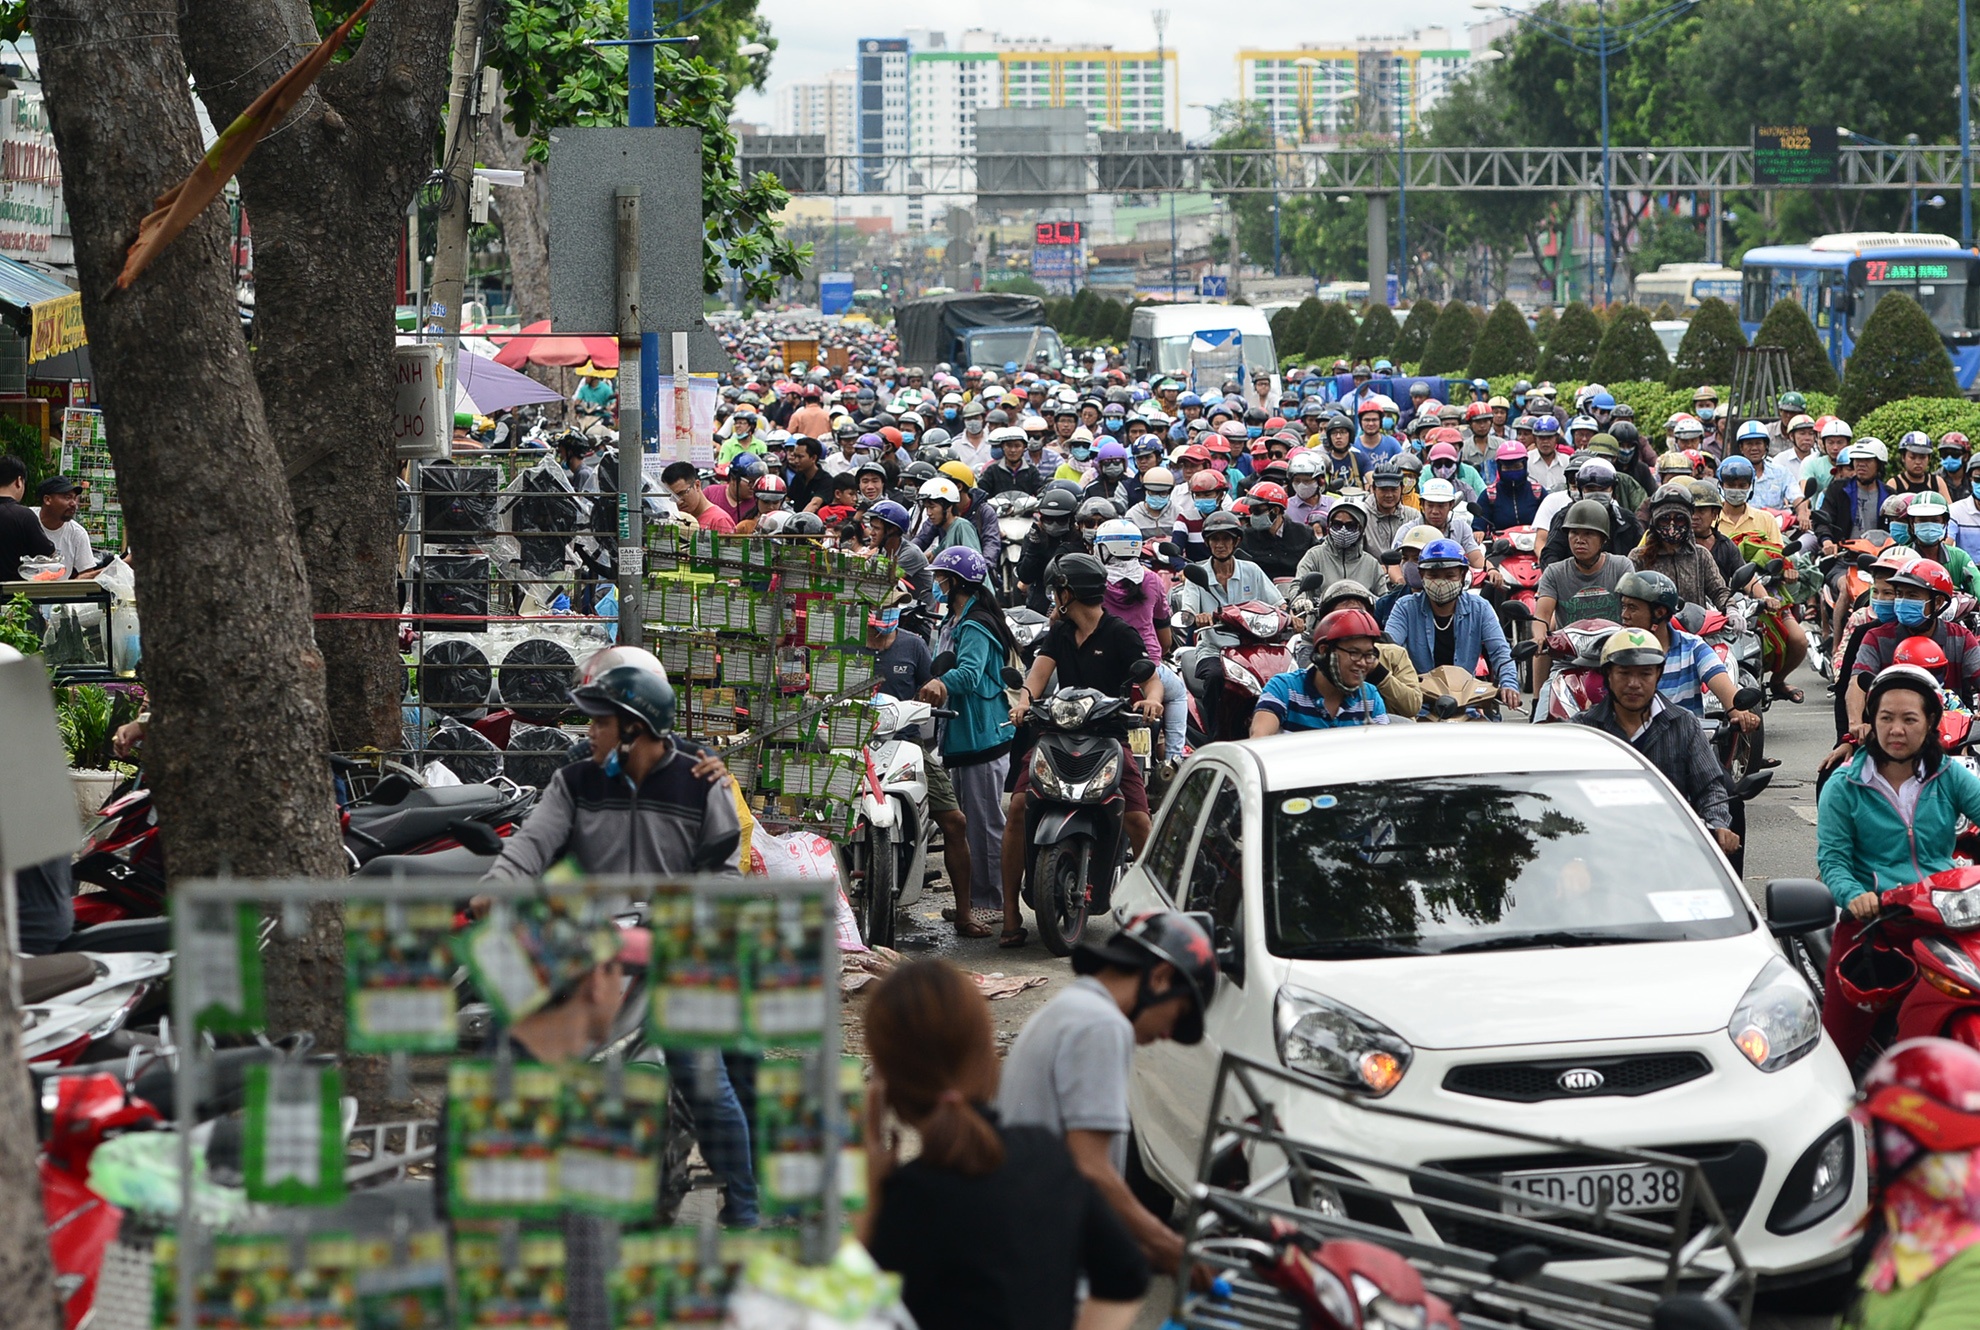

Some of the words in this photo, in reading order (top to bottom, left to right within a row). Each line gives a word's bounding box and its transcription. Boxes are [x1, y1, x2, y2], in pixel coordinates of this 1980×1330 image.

[1779, 136, 1811, 149] 1022
[1866, 261, 1888, 281] 27
[1565, 1073, 1597, 1089] KIA
